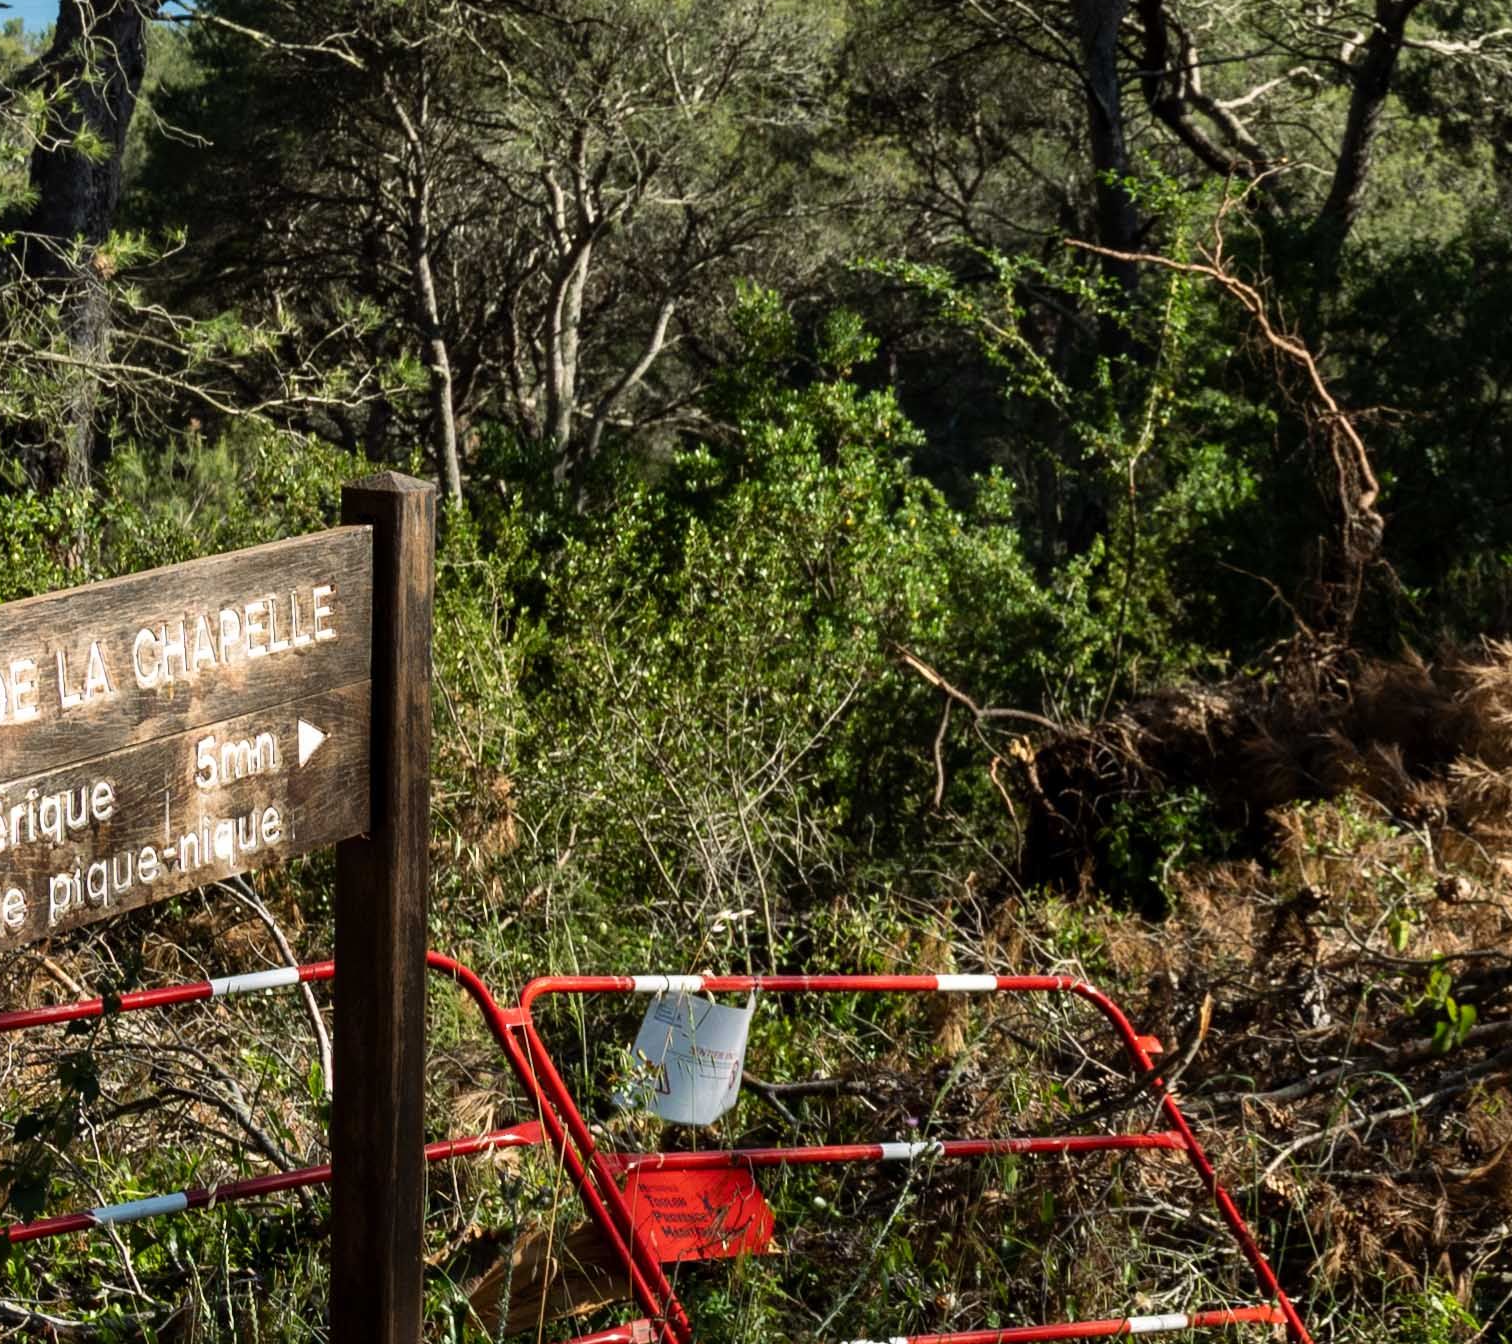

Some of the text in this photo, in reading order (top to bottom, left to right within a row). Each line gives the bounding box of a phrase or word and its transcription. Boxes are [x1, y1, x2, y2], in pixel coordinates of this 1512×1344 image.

[56, 640, 115, 709] LA
[133, 584, 337, 689] CHAPELLE
[194, 731, 278, 788] 5mn
[49, 806, 283, 928] pique-nique
